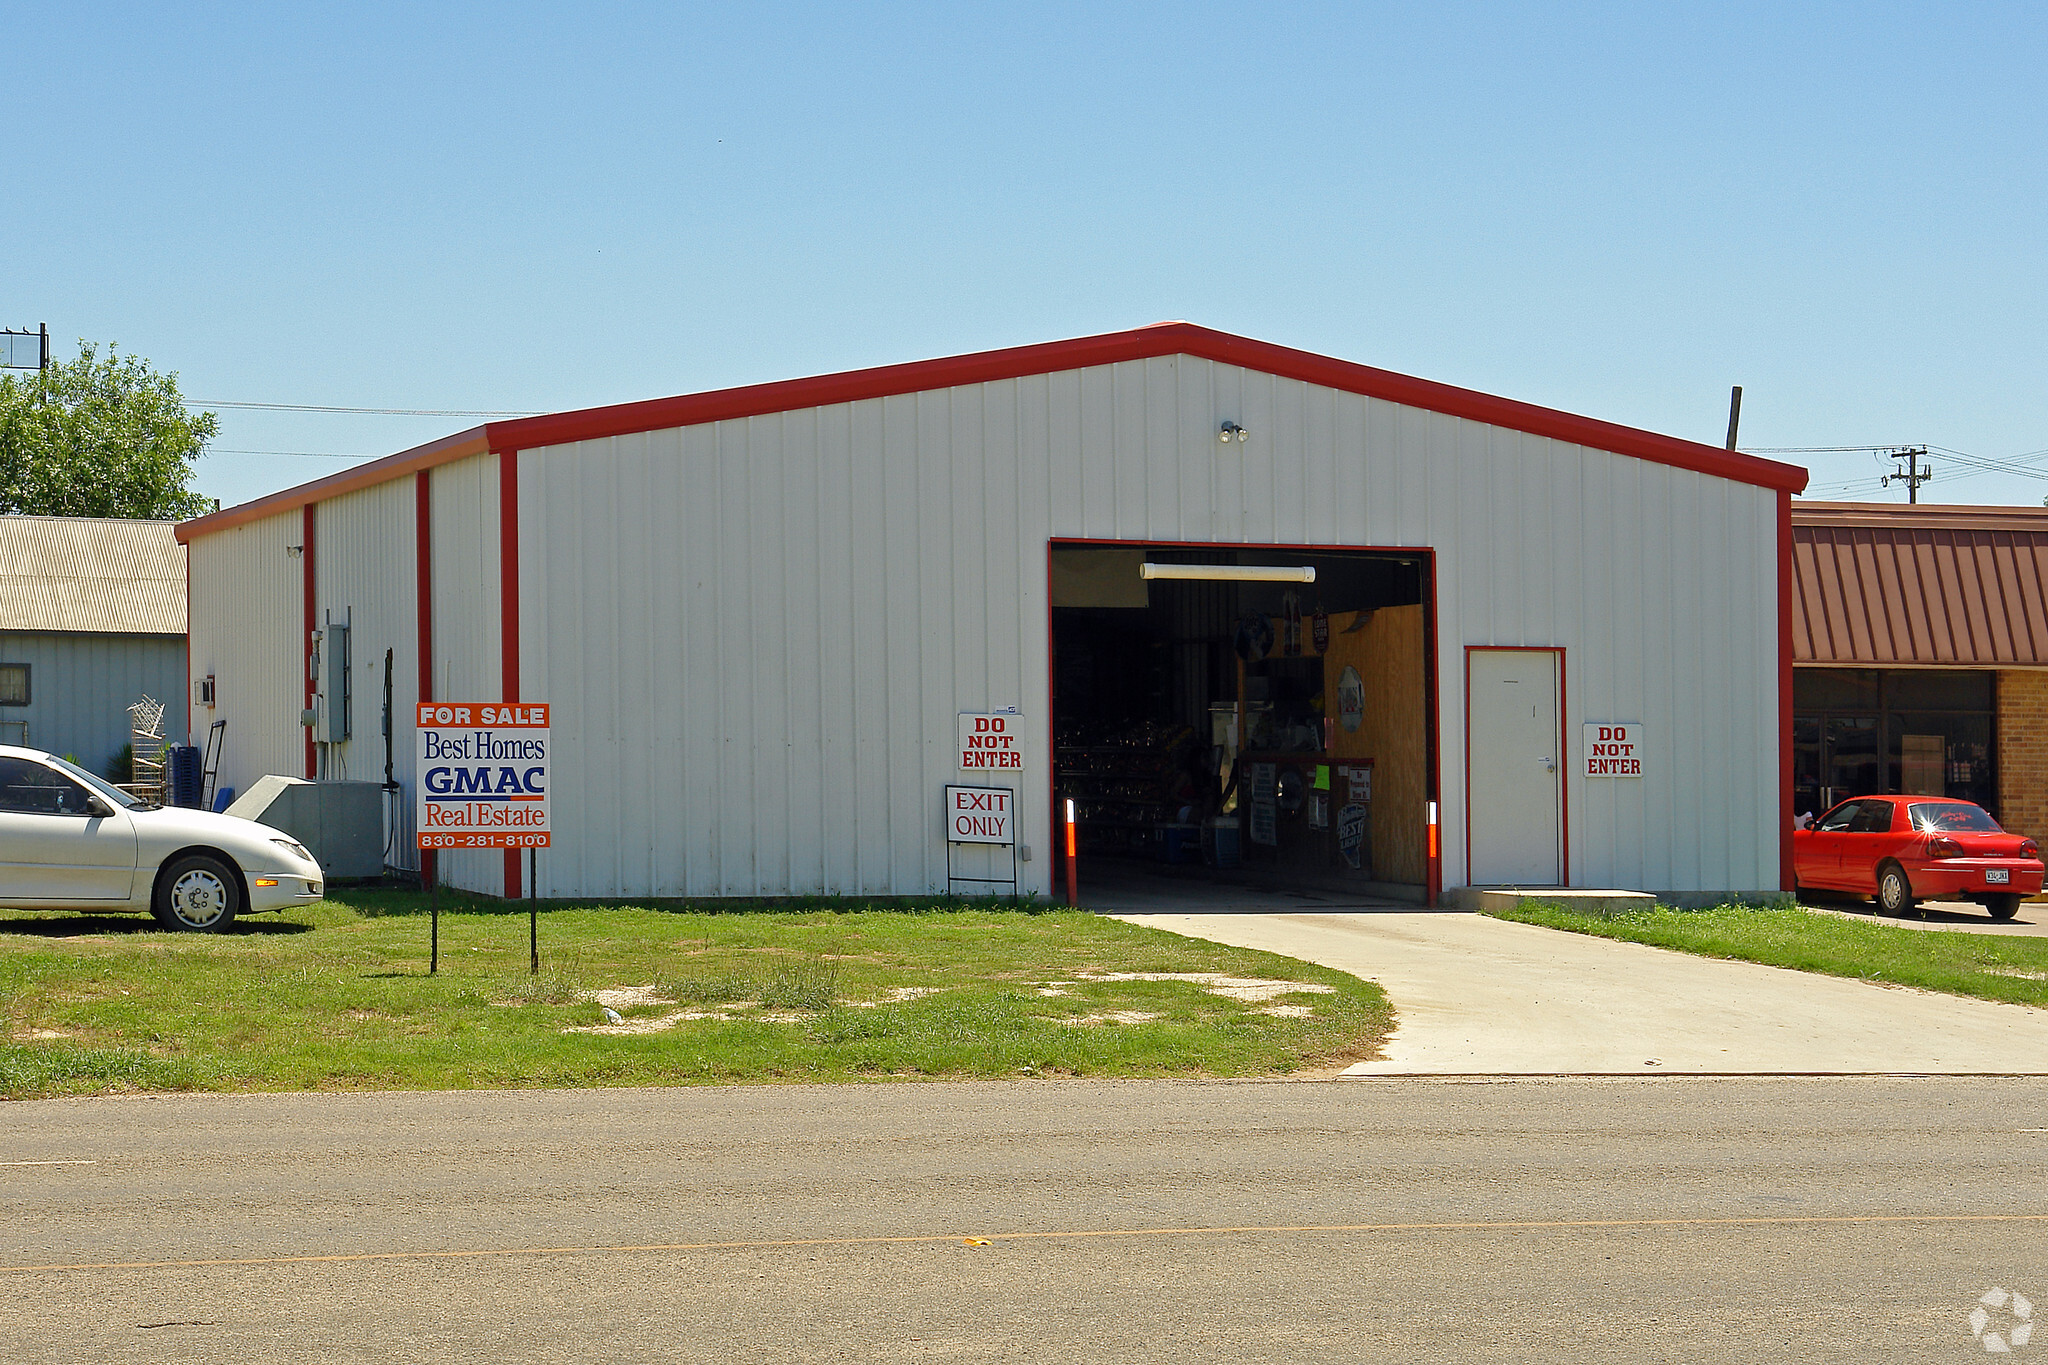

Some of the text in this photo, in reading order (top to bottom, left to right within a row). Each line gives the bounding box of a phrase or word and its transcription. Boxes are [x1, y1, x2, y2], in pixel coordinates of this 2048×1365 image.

[420, 706, 545, 725] FOR SALE
[974, 717, 1005, 732] DO
[967, 735, 1014, 749] NOT
[1598, 726, 1626, 741] DO
[423, 731, 545, 760] Best Homes
[1592, 743, 1634, 756] NOT
[962, 751, 1021, 767] ENTER
[1587, 758, 1641, 774] ENTER
[424, 766, 545, 793] GMAC
[956, 792, 1009, 811] EXIT
[424, 802, 545, 827] Real Estate
[955, 815, 1006, 836] ONLY
[1339, 822, 1363, 840] BEST
[421, 835, 547, 847] 830-281-8100
